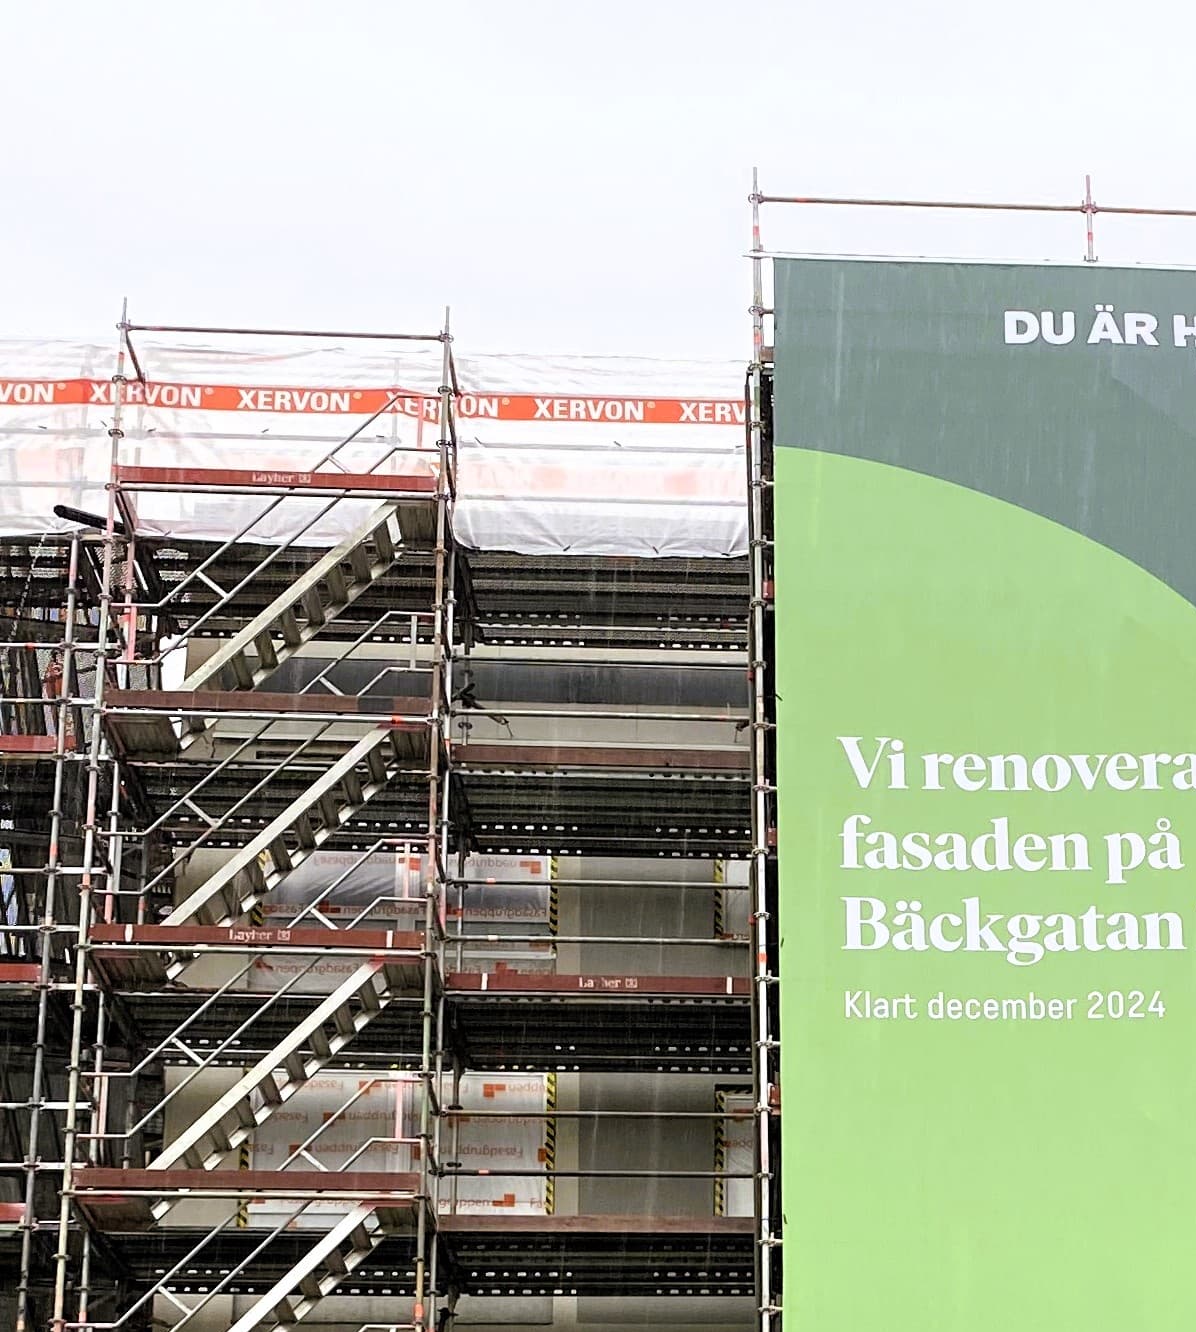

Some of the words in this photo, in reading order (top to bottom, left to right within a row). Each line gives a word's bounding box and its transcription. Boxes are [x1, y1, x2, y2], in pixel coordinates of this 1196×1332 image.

[1004, 311, 1075, 345] DU
[1087, 304, 1160, 346] ÄR
[236, 389, 351, 413] XERVON
[533, 399, 645, 422] XERVON
[836, 736, 910, 790] Vi
[838, 814, 1093, 872] fasaden
[1104, 817, 1185, 884] på
[840, 896, 1187, 966] Bäckgatan
[844, 990, 918, 1020] Klart
[927, 991, 1077, 1020] december
[1087, 990, 1166, 1020] 2024
